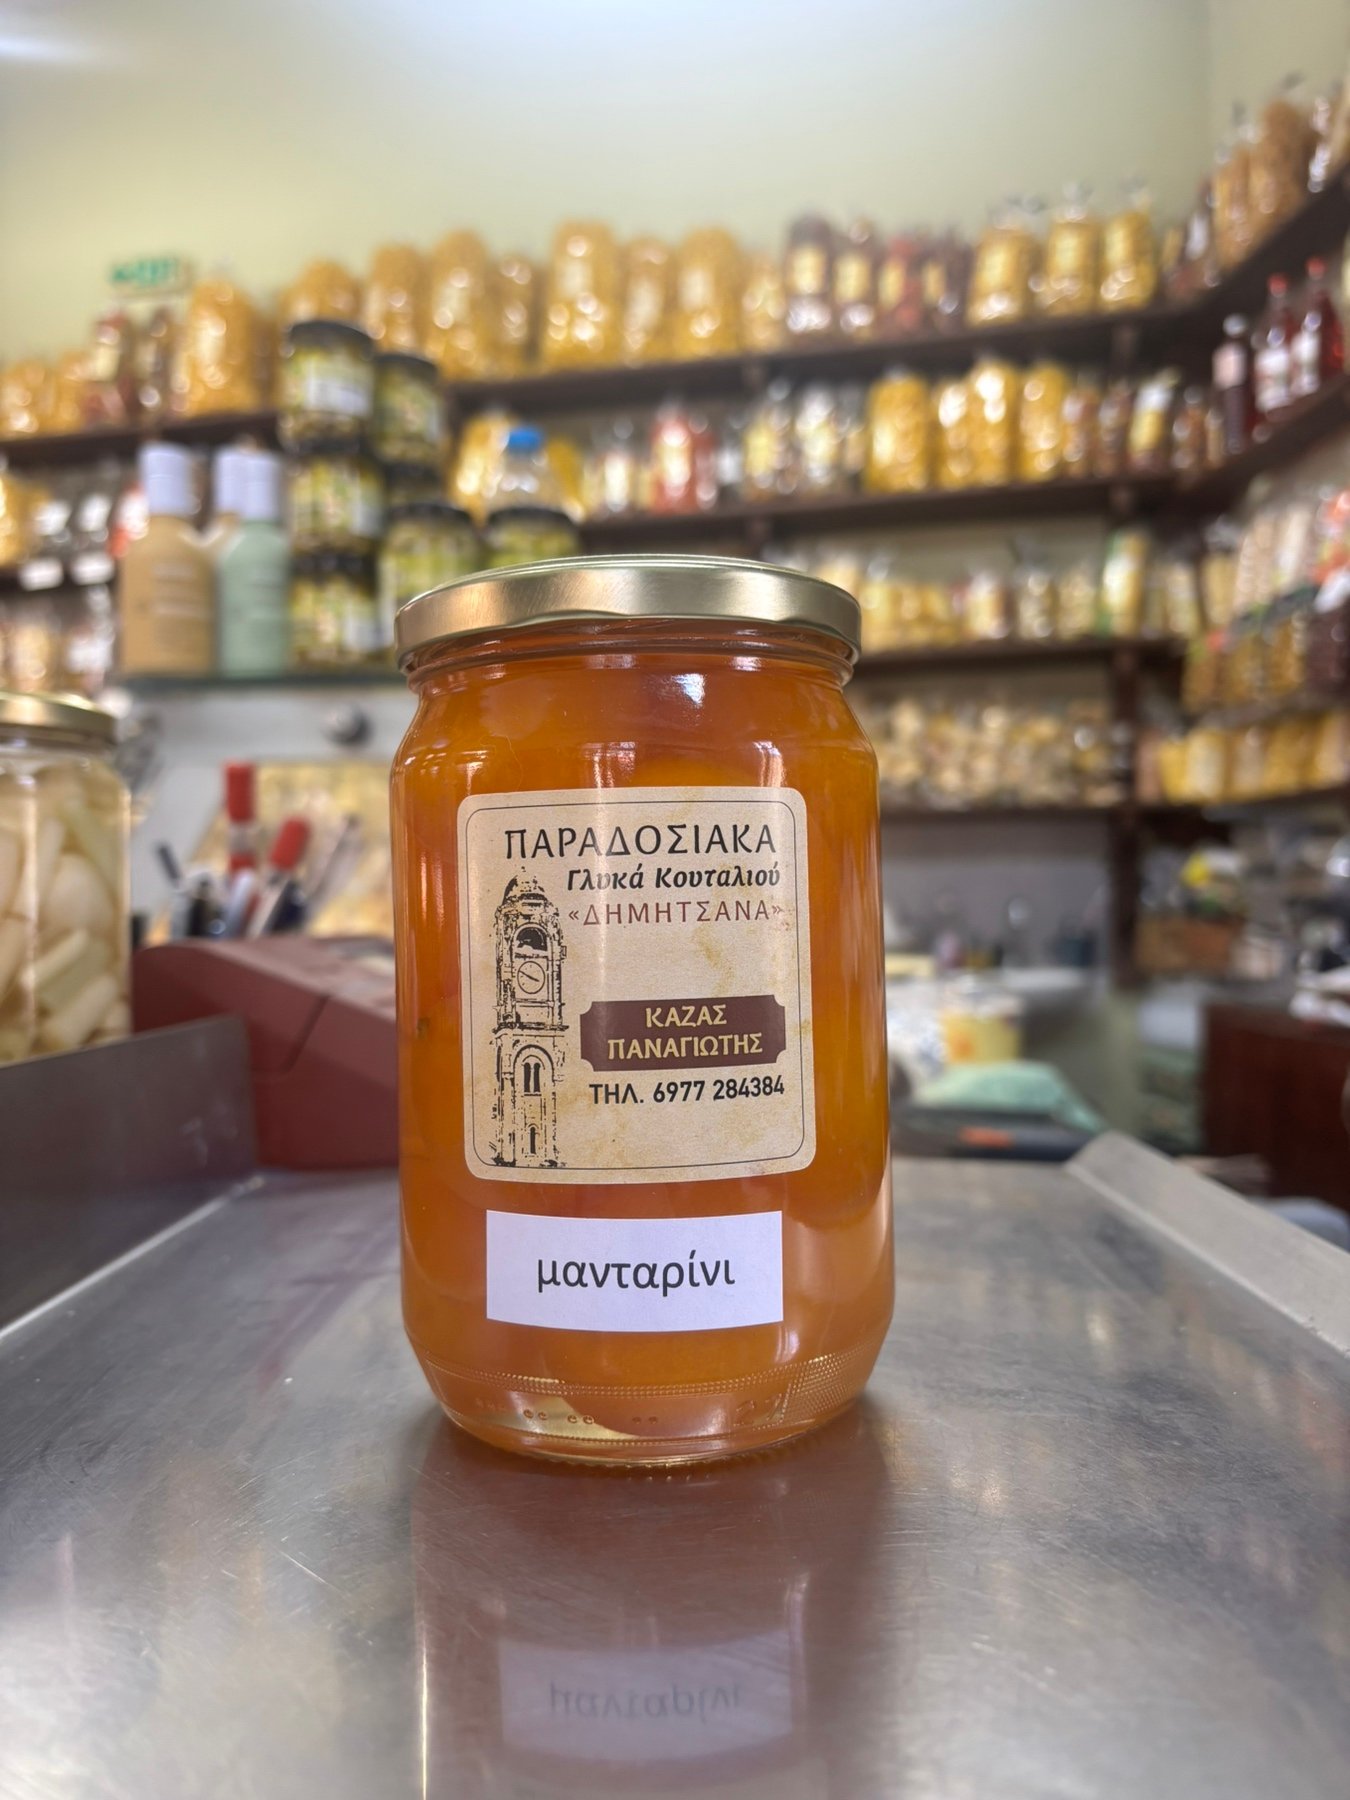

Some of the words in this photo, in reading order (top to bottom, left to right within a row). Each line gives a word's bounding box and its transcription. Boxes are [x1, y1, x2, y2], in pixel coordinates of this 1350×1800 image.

[505, 823, 777, 859] ΠΑΡΑΔΟΣΙΑΚΑ
[567, 863, 644, 891] Γλυκά
[655, 863, 780, 889] Κουταλιού
[645, 1004, 727, 1028] ΚΑΖΑΣ
[607, 1032, 763, 1060] ΠΑΝΑΓΙΩΤΗΣ
[589, 1083, 645, 1105] ΤΗΛ.
[652, 1080, 706, 1103] 6977
[712, 1074, 785, 1101] 284384
[538, 1249, 736, 1298] μανταρίνι
